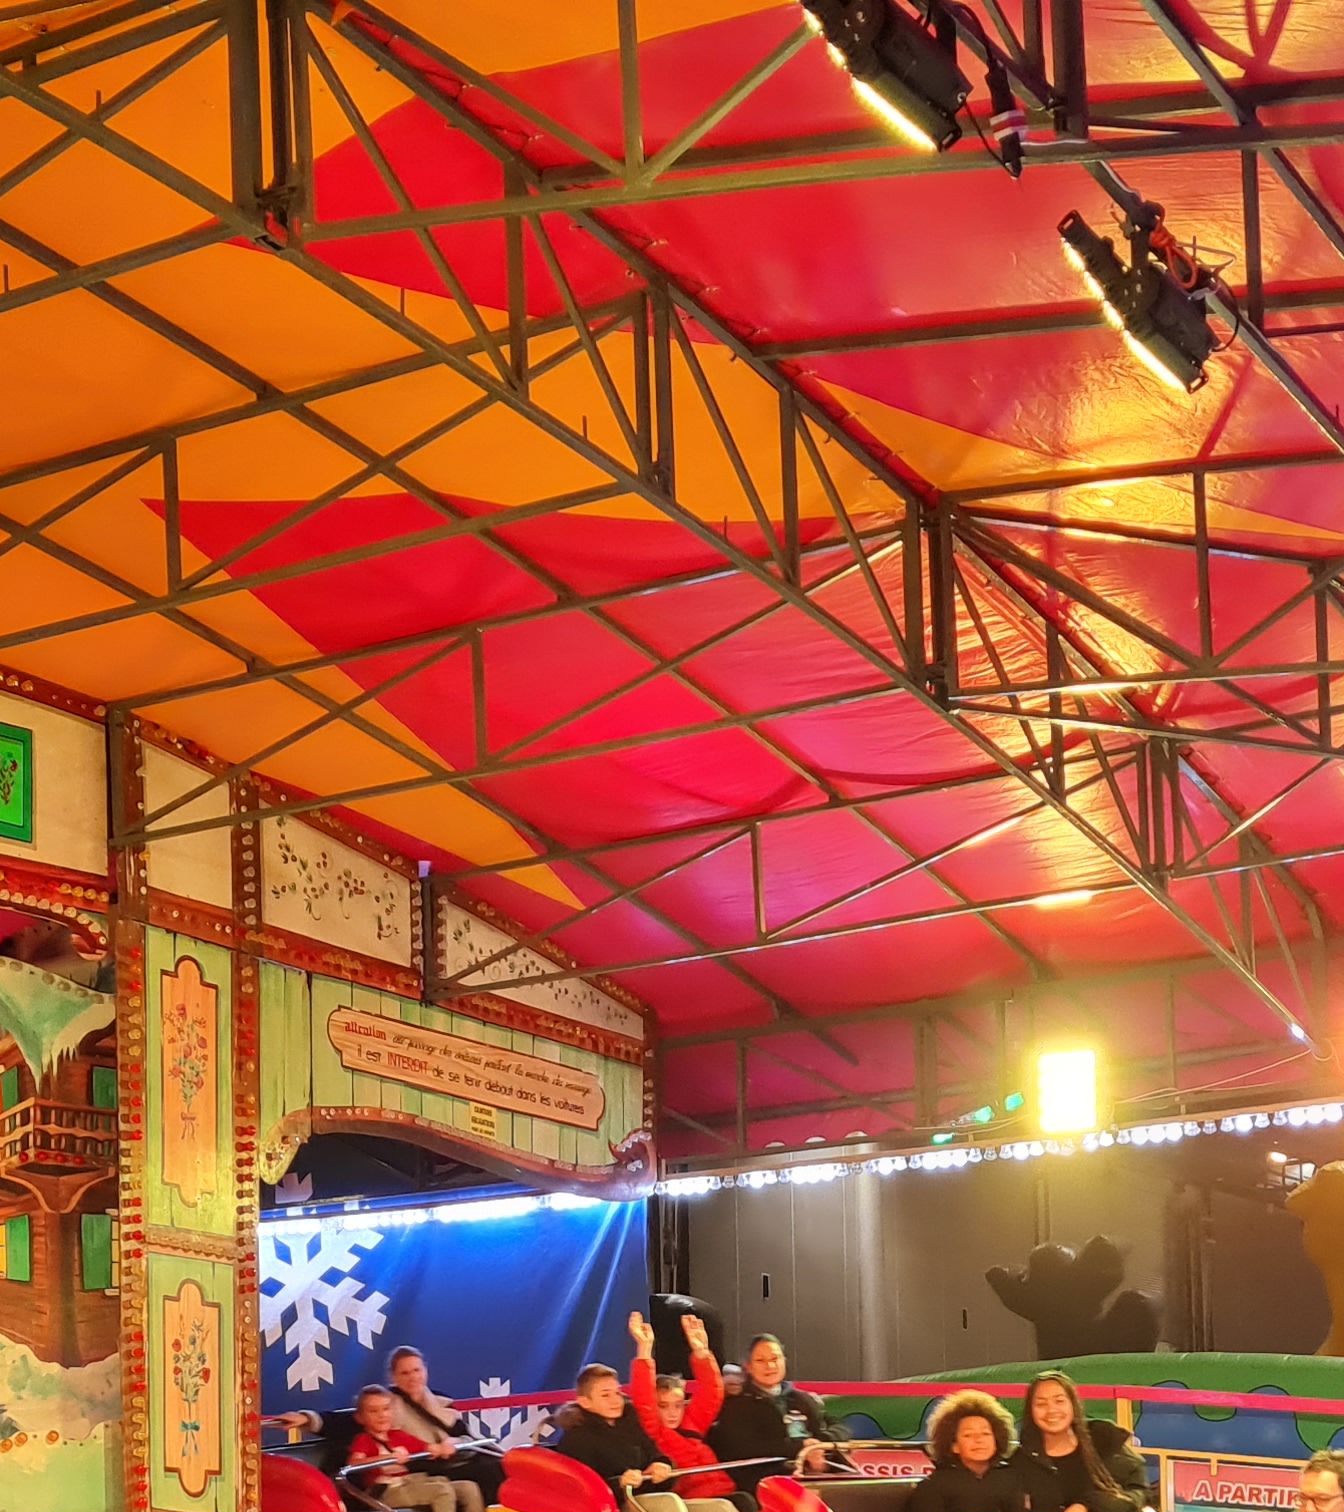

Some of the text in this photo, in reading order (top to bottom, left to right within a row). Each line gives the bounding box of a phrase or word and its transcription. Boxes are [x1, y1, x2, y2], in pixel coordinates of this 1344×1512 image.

[387, 1051, 429, 1075] INTERDIT
[432, 1064, 445, 1080] de
[448, 1071, 460, 1083] se
[516, 1087, 537, 1103] dans
[540, 1091, 551, 1107] les
[1195, 1481, 1213, 1501] A
